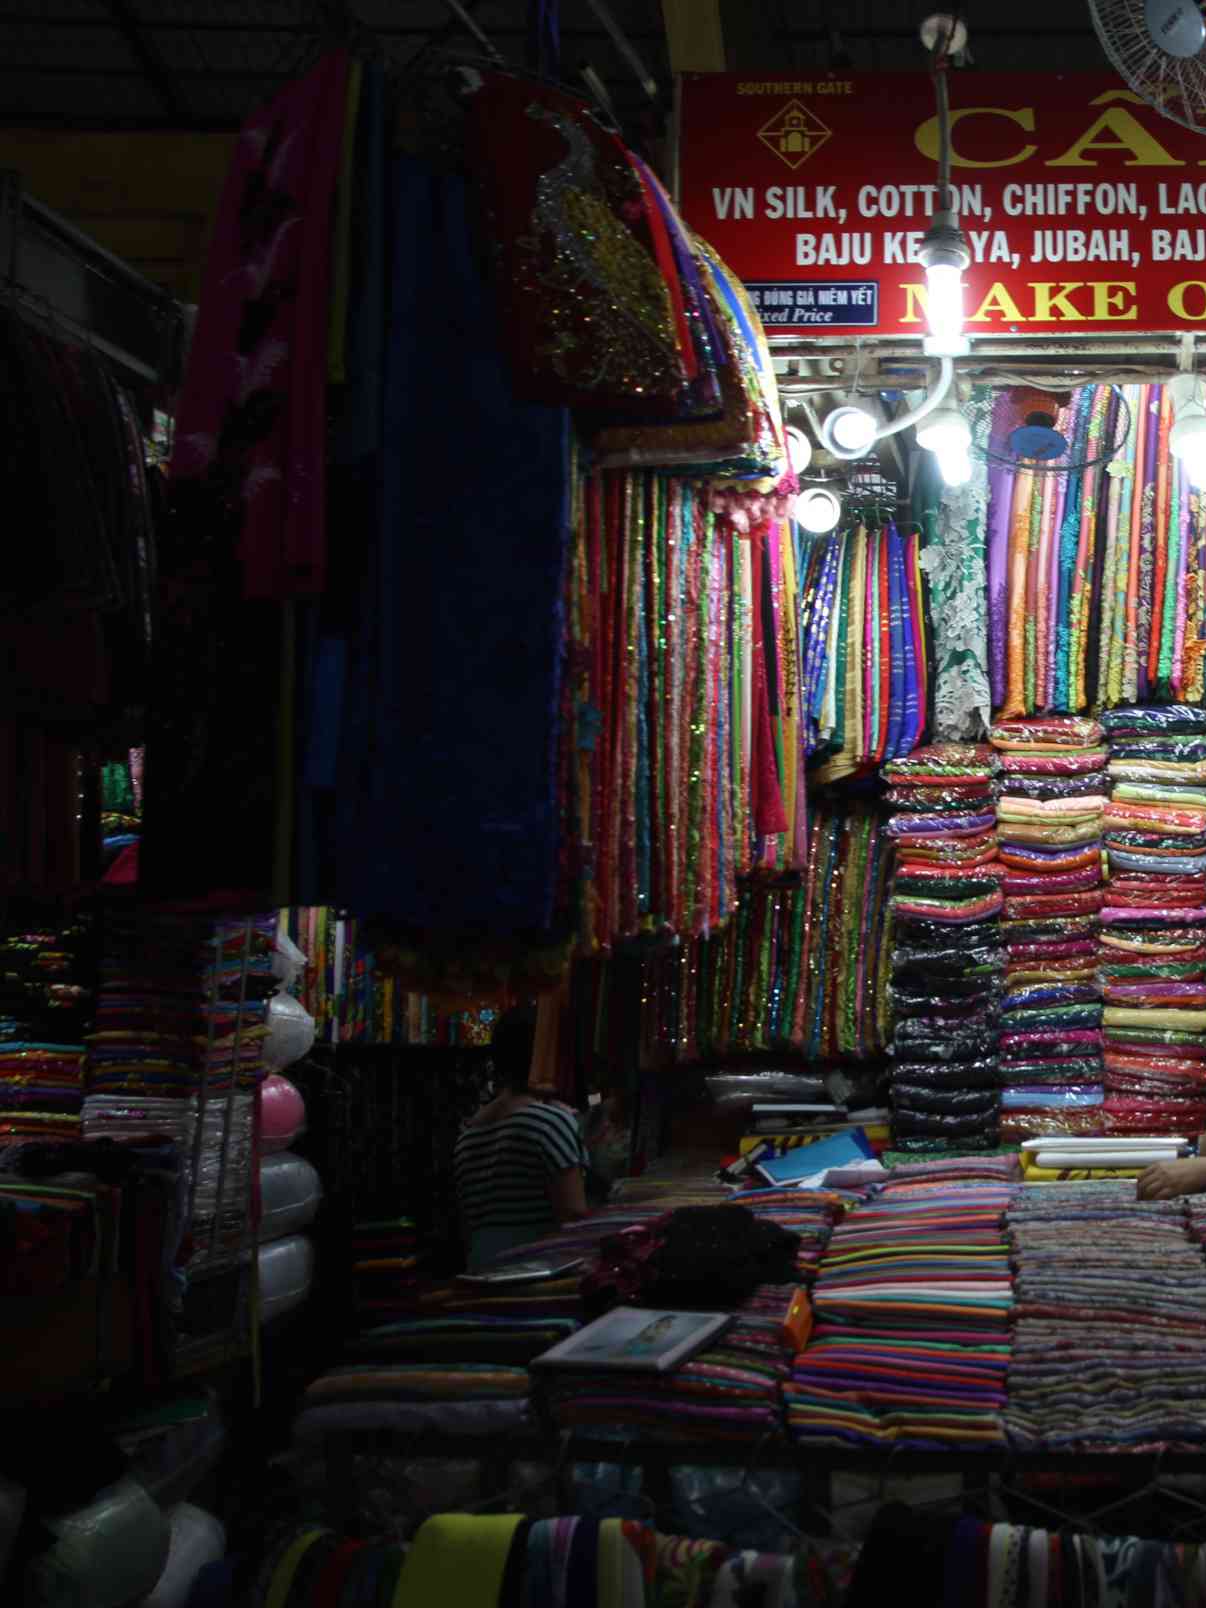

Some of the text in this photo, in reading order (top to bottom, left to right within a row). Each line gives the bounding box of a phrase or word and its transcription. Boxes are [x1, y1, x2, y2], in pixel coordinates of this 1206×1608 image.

[736, 81, 854, 95] SOUTHERN GATE
[713, 187, 754, 220] VN
[765, 186, 848, 224] SILK,
[858, 183, 992, 223] COTTON,
[1002, 182, 1147, 222] CHIFFON,
[795, 231, 872, 266] BAJU
[884, 230, 1021, 269] KEYA,
[1031, 228, 1141, 268] JUBAH,
[758, 308, 833, 323] ixed Price
